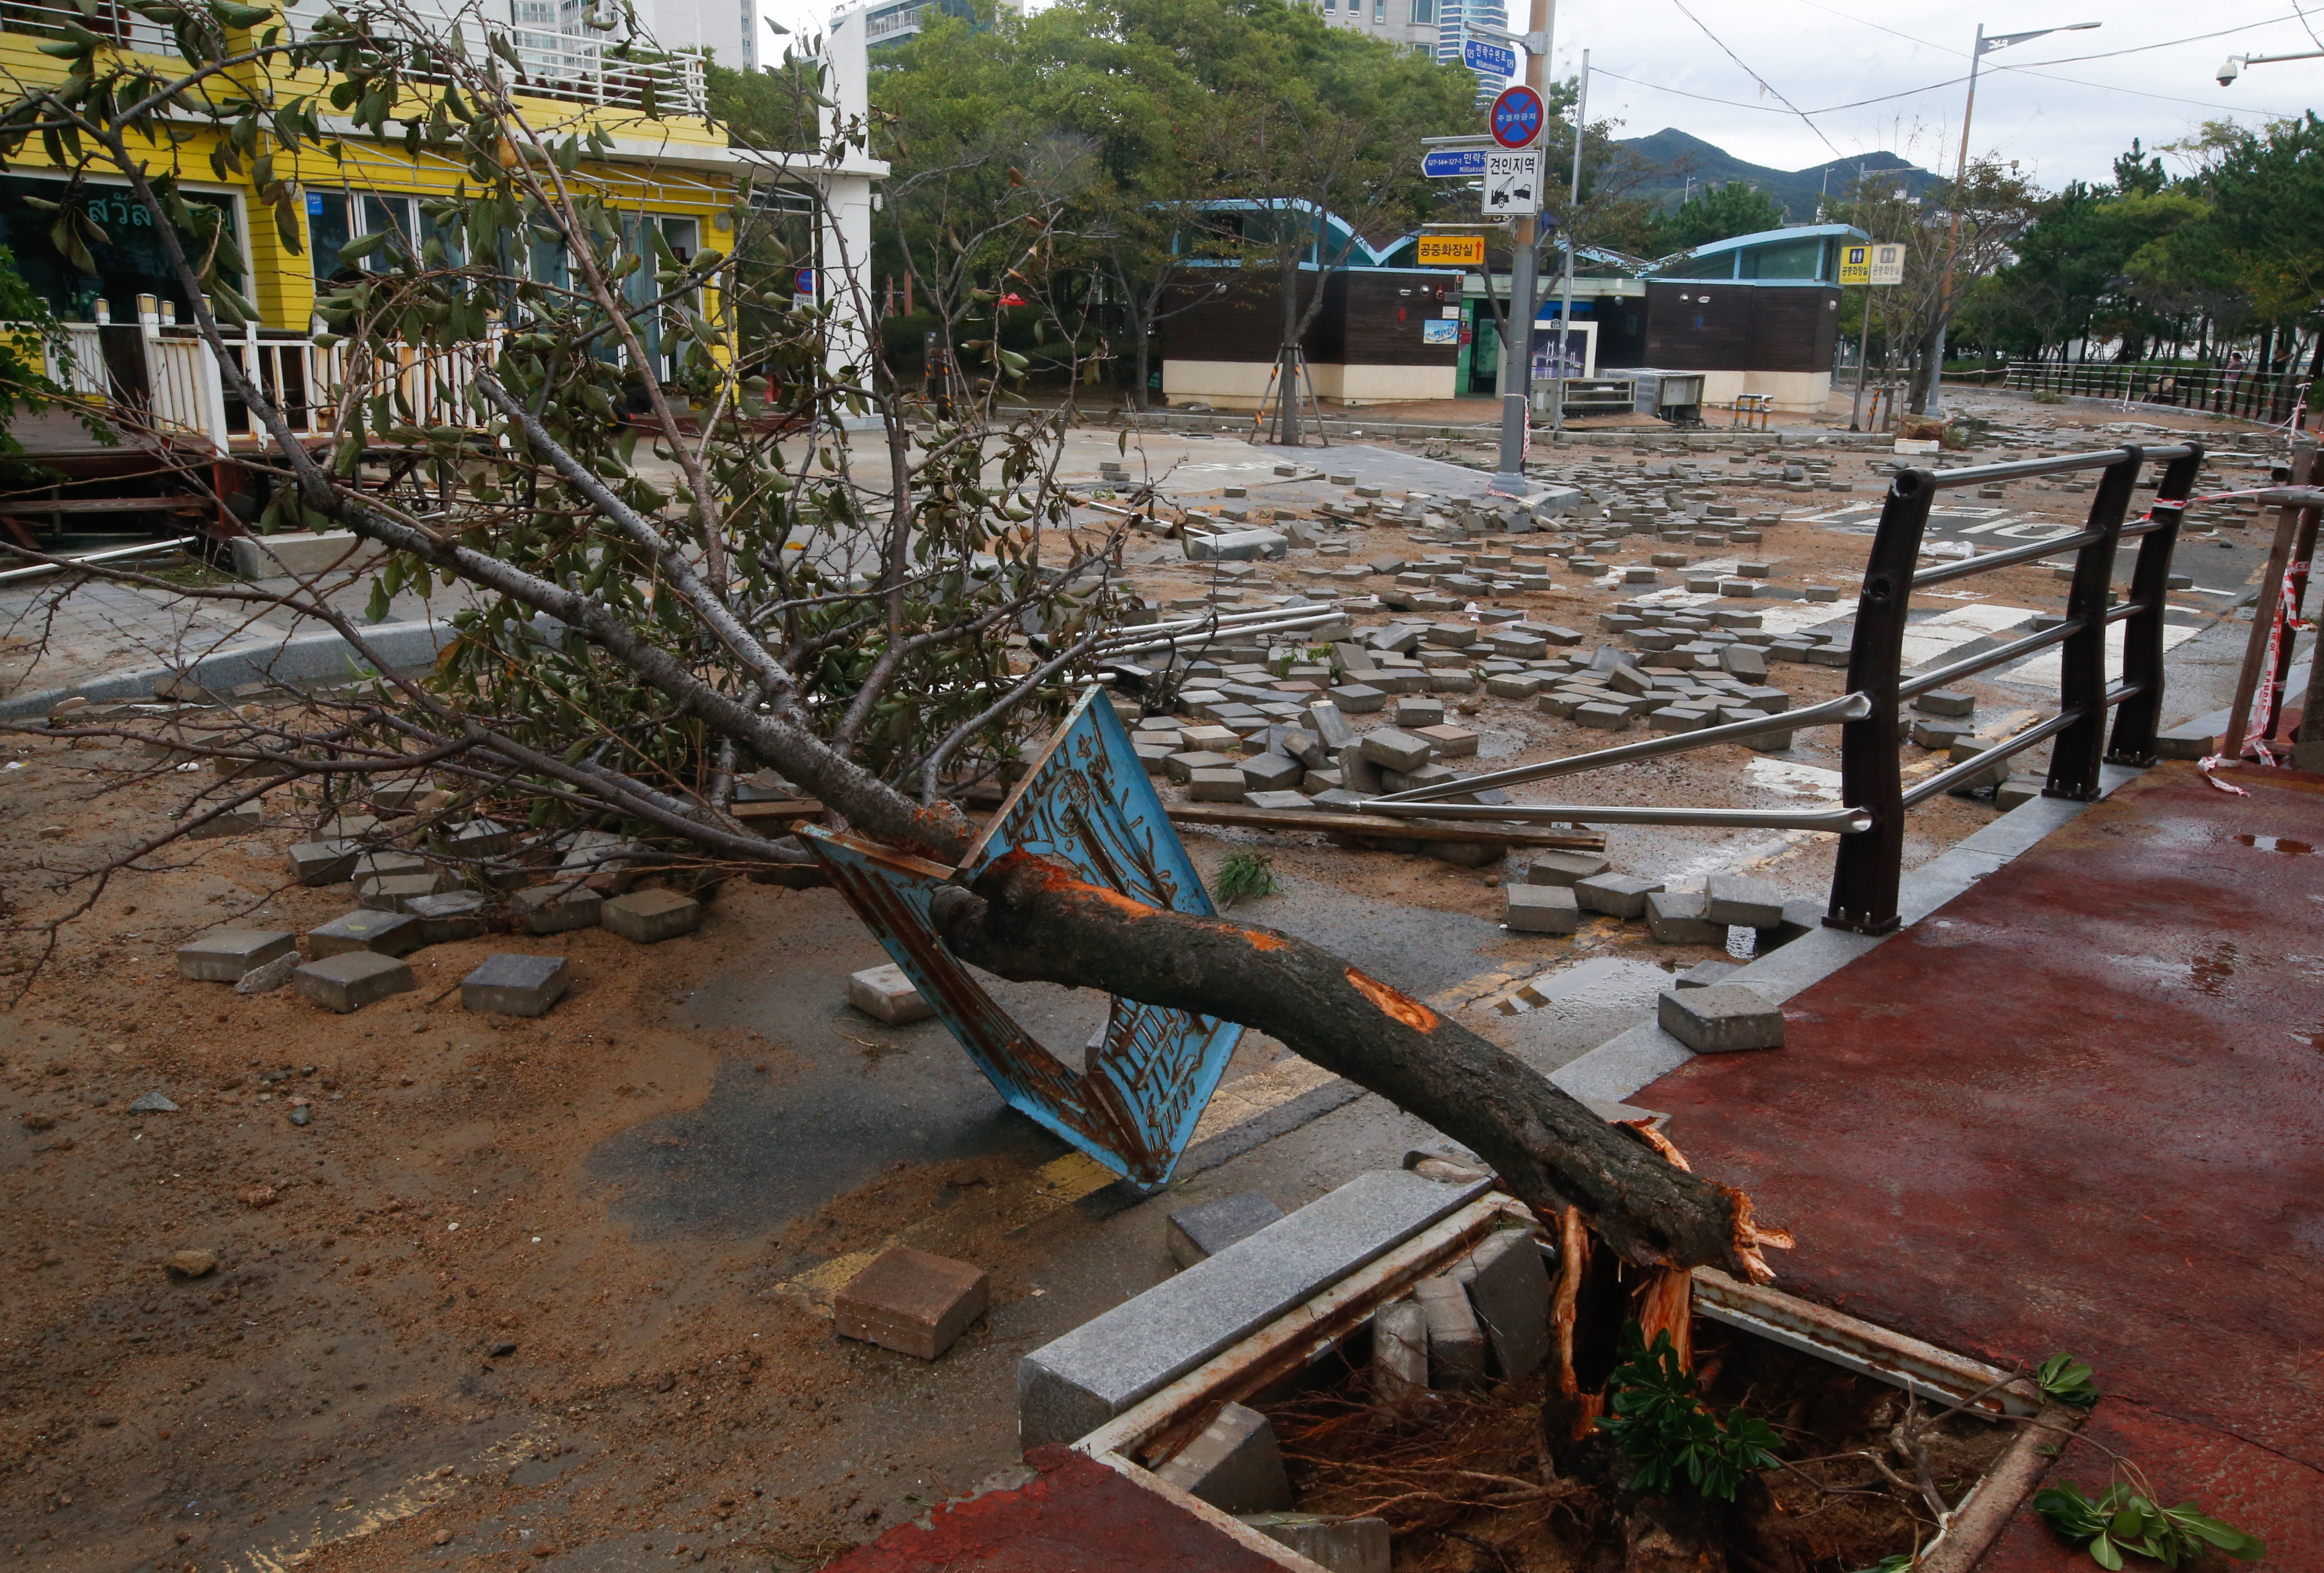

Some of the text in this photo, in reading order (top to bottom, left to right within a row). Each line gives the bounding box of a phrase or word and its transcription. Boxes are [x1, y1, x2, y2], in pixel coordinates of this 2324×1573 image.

[1476, 44, 1506, 62] 민락수변로
[1498, 112, 1536, 122] 주정차금지
[1490, 157, 1534, 175] 견인지역
[1420, 244, 1473, 256] 공중화장실
[1842, 266, 1868, 277] 공중화장실
[1873, 266, 1900, 276] 공중화장실
